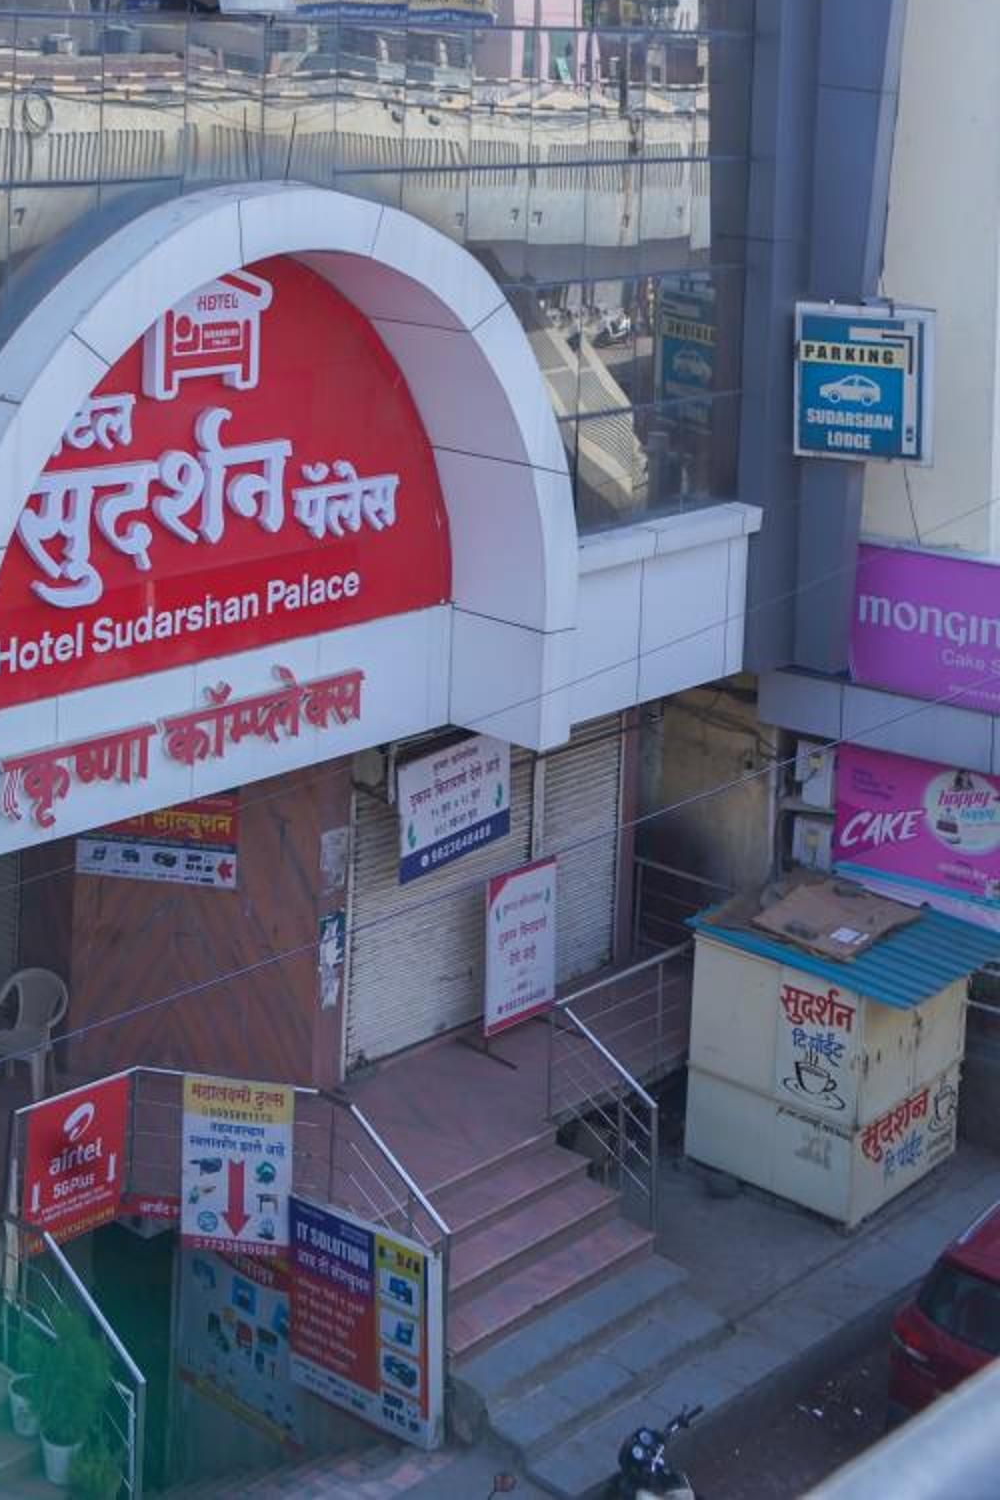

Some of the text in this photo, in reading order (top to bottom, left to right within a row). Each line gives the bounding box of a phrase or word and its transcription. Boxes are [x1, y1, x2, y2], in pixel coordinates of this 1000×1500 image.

[197, 292, 239, 312] HOTEL
[804, 343, 895, 366] PARKING
[807, 407, 894, 431] SUDARSHAN
[826, 431, 872, 449] LODGE
[17, 406, 400, 609] सुदर्शन पॅलेस
[92, 593, 260, 655] Sudarshan
[266, 569, 361, 615] Palace
[838, 807, 924, 847] CAKE
[779, 983, 857, 1033] सुदर्शन
[48, 1136, 104, 1177] airtel
[296, 1220, 309, 1242] IT
